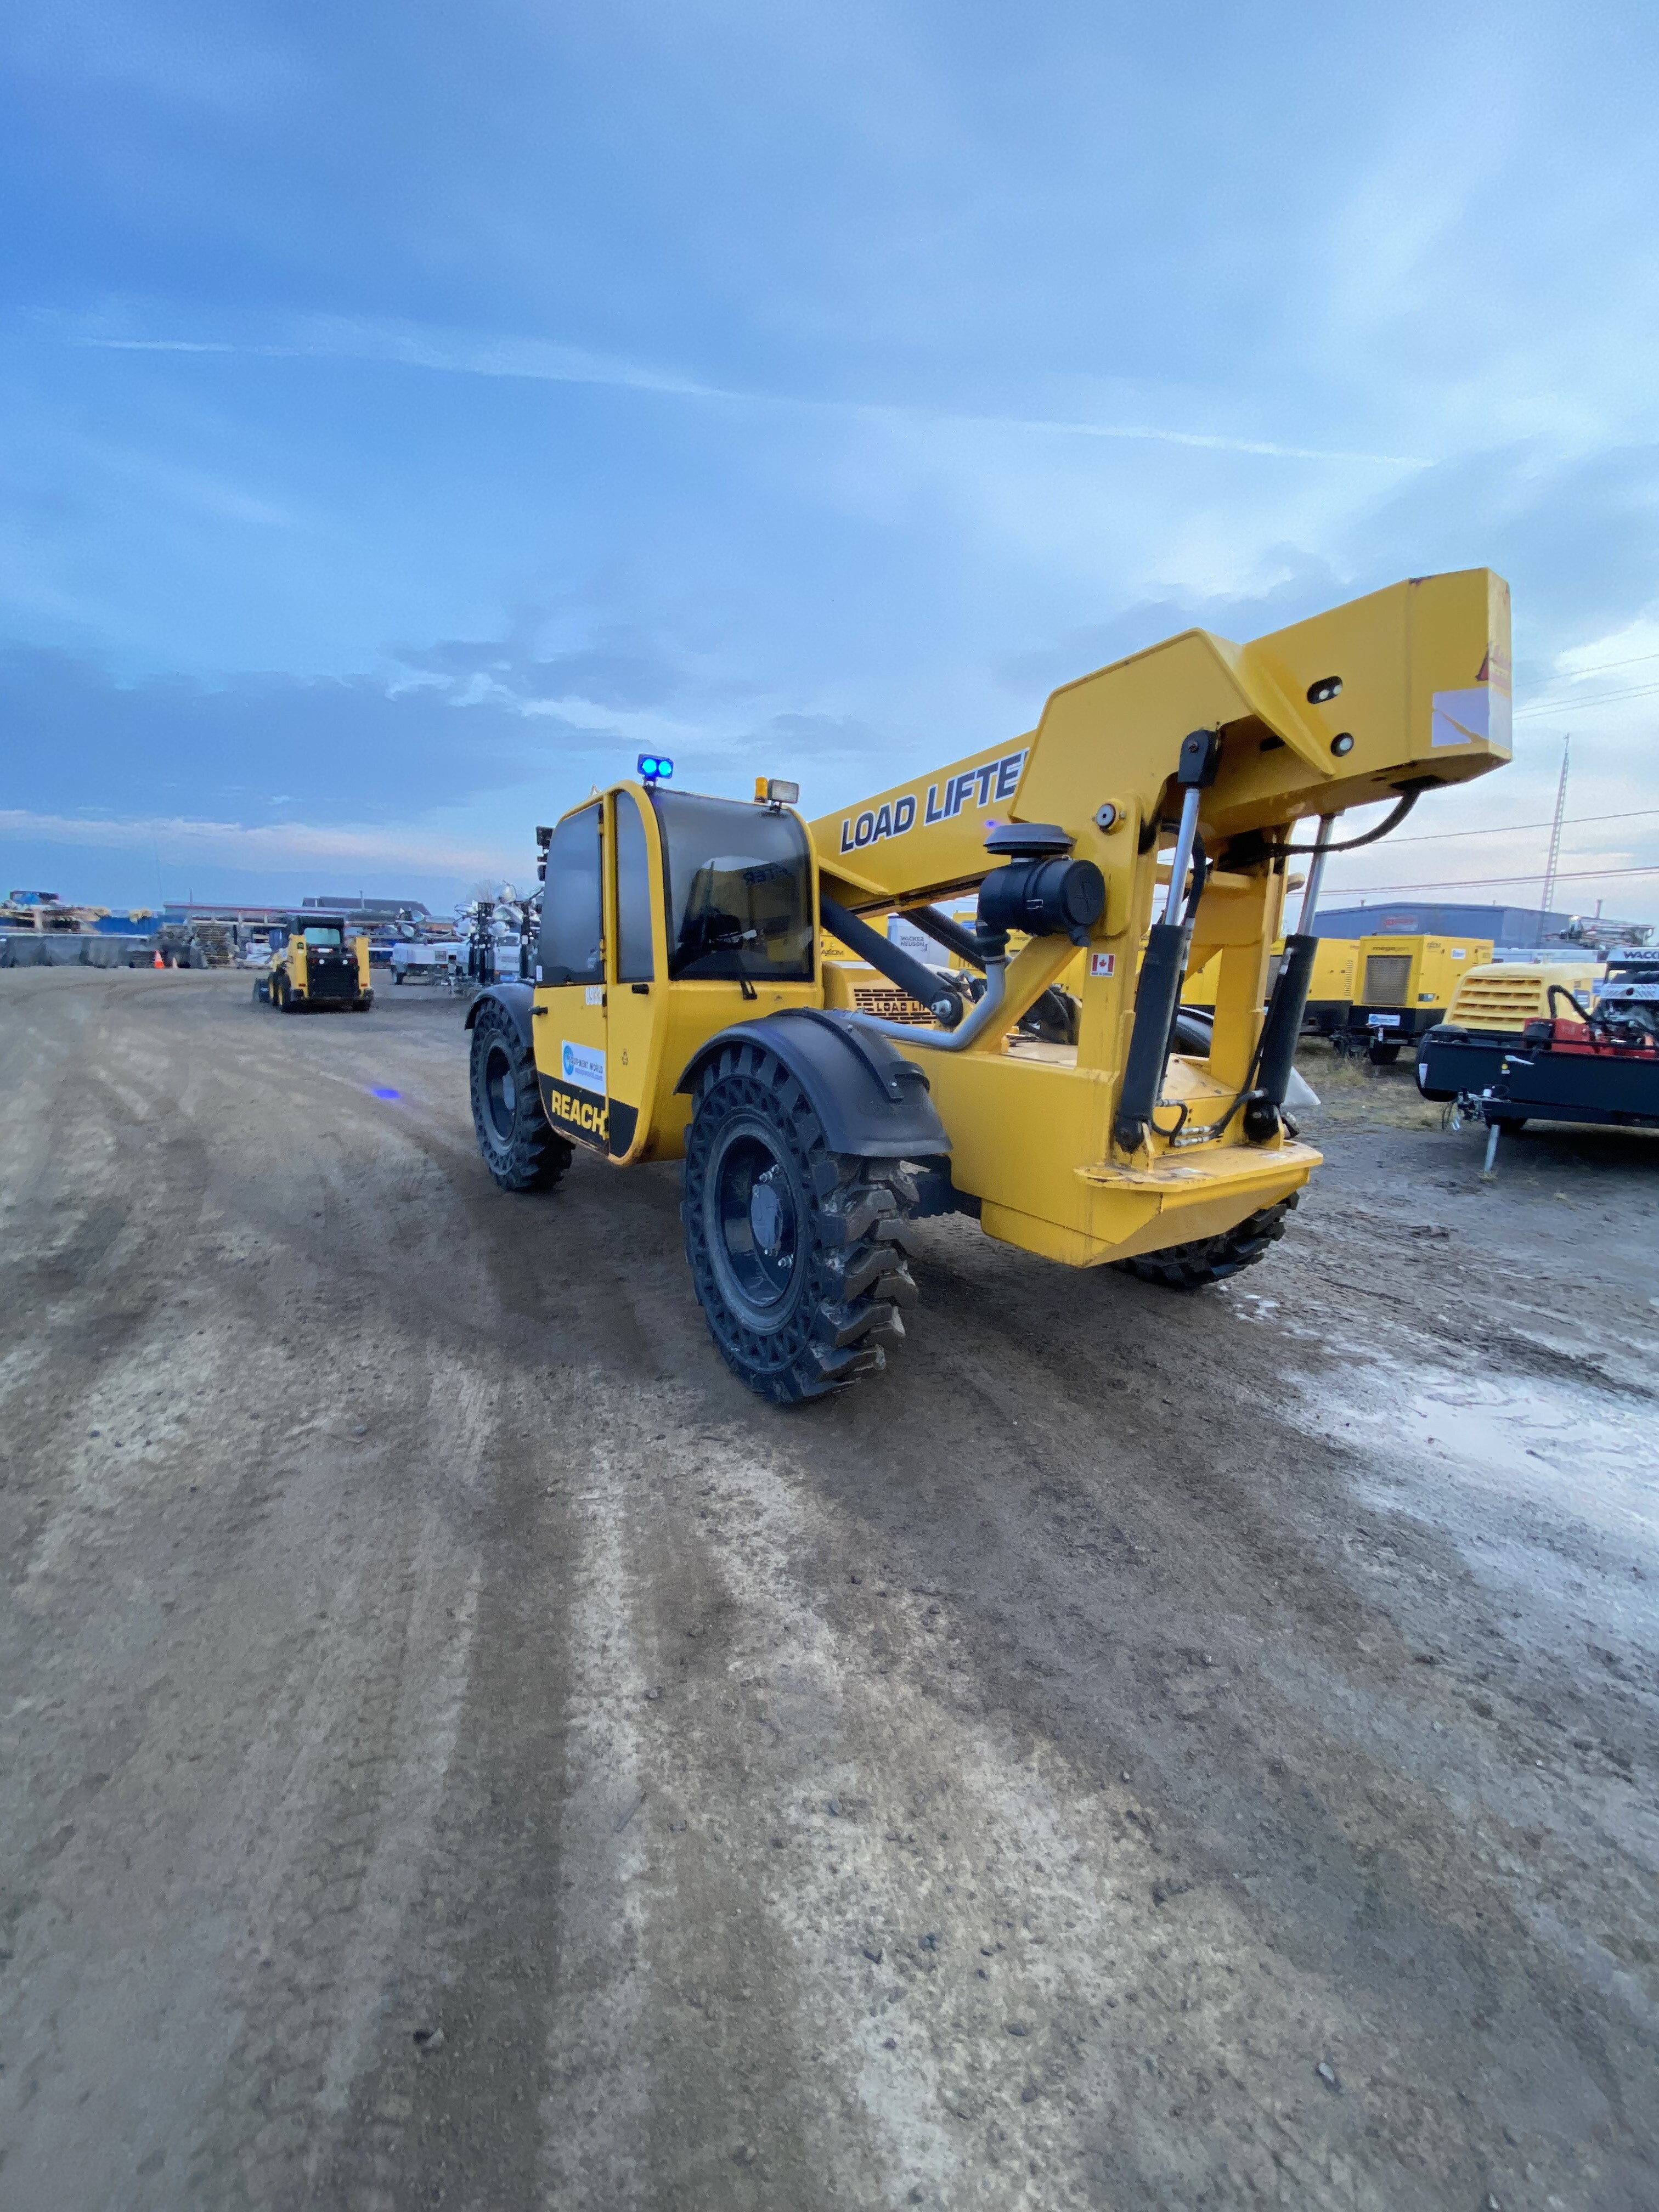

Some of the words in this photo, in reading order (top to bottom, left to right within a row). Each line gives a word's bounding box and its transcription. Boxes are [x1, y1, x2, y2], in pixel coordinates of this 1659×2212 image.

[840, 794, 917, 856] LOAD
[877, 1002, 907, 1012] LOAD
[590, 1062, 603, 1074] WORLD
[551, 1090, 605, 1138] REACH
